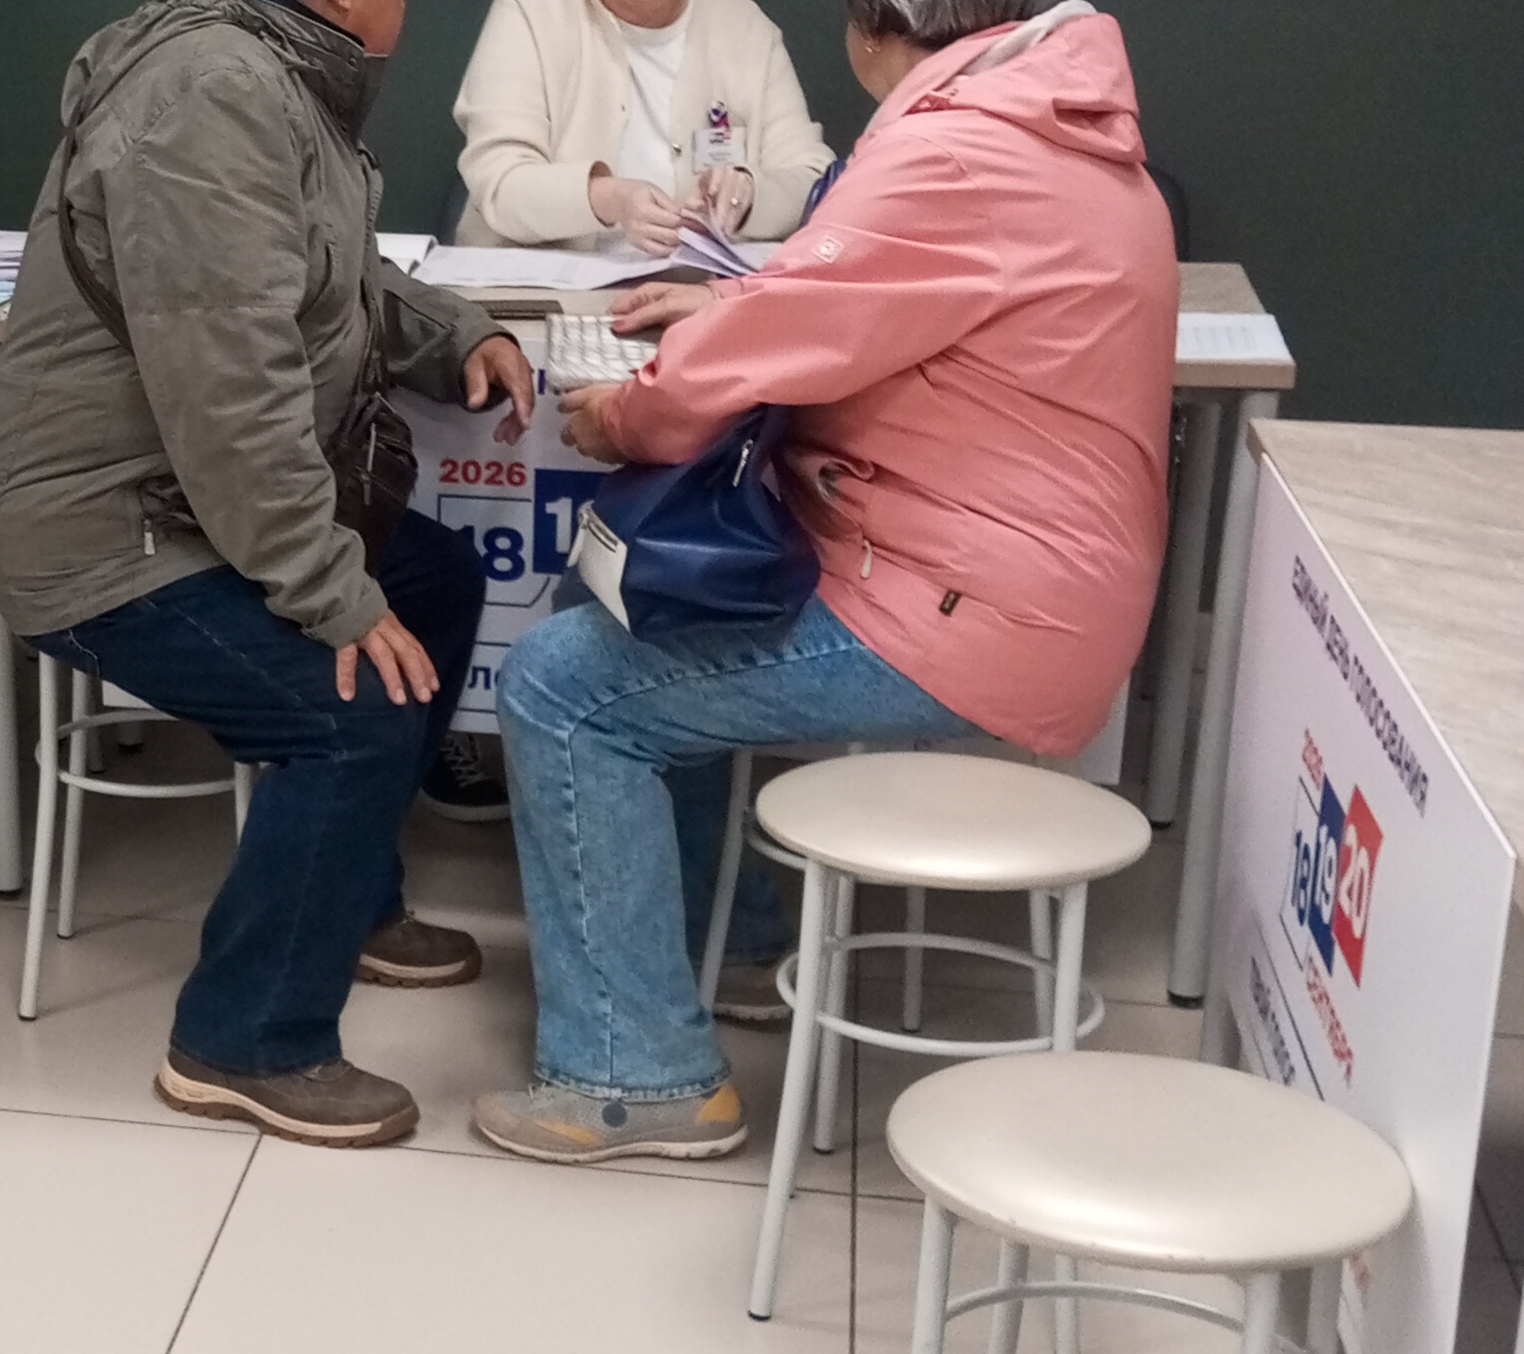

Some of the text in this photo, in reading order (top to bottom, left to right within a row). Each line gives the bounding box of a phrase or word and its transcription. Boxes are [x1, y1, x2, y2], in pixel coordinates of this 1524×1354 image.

[439, 458, 527, 487] 2026
[457, 497, 573, 582] 8 1
[1290, 822, 1371, 939] 18 19 20
